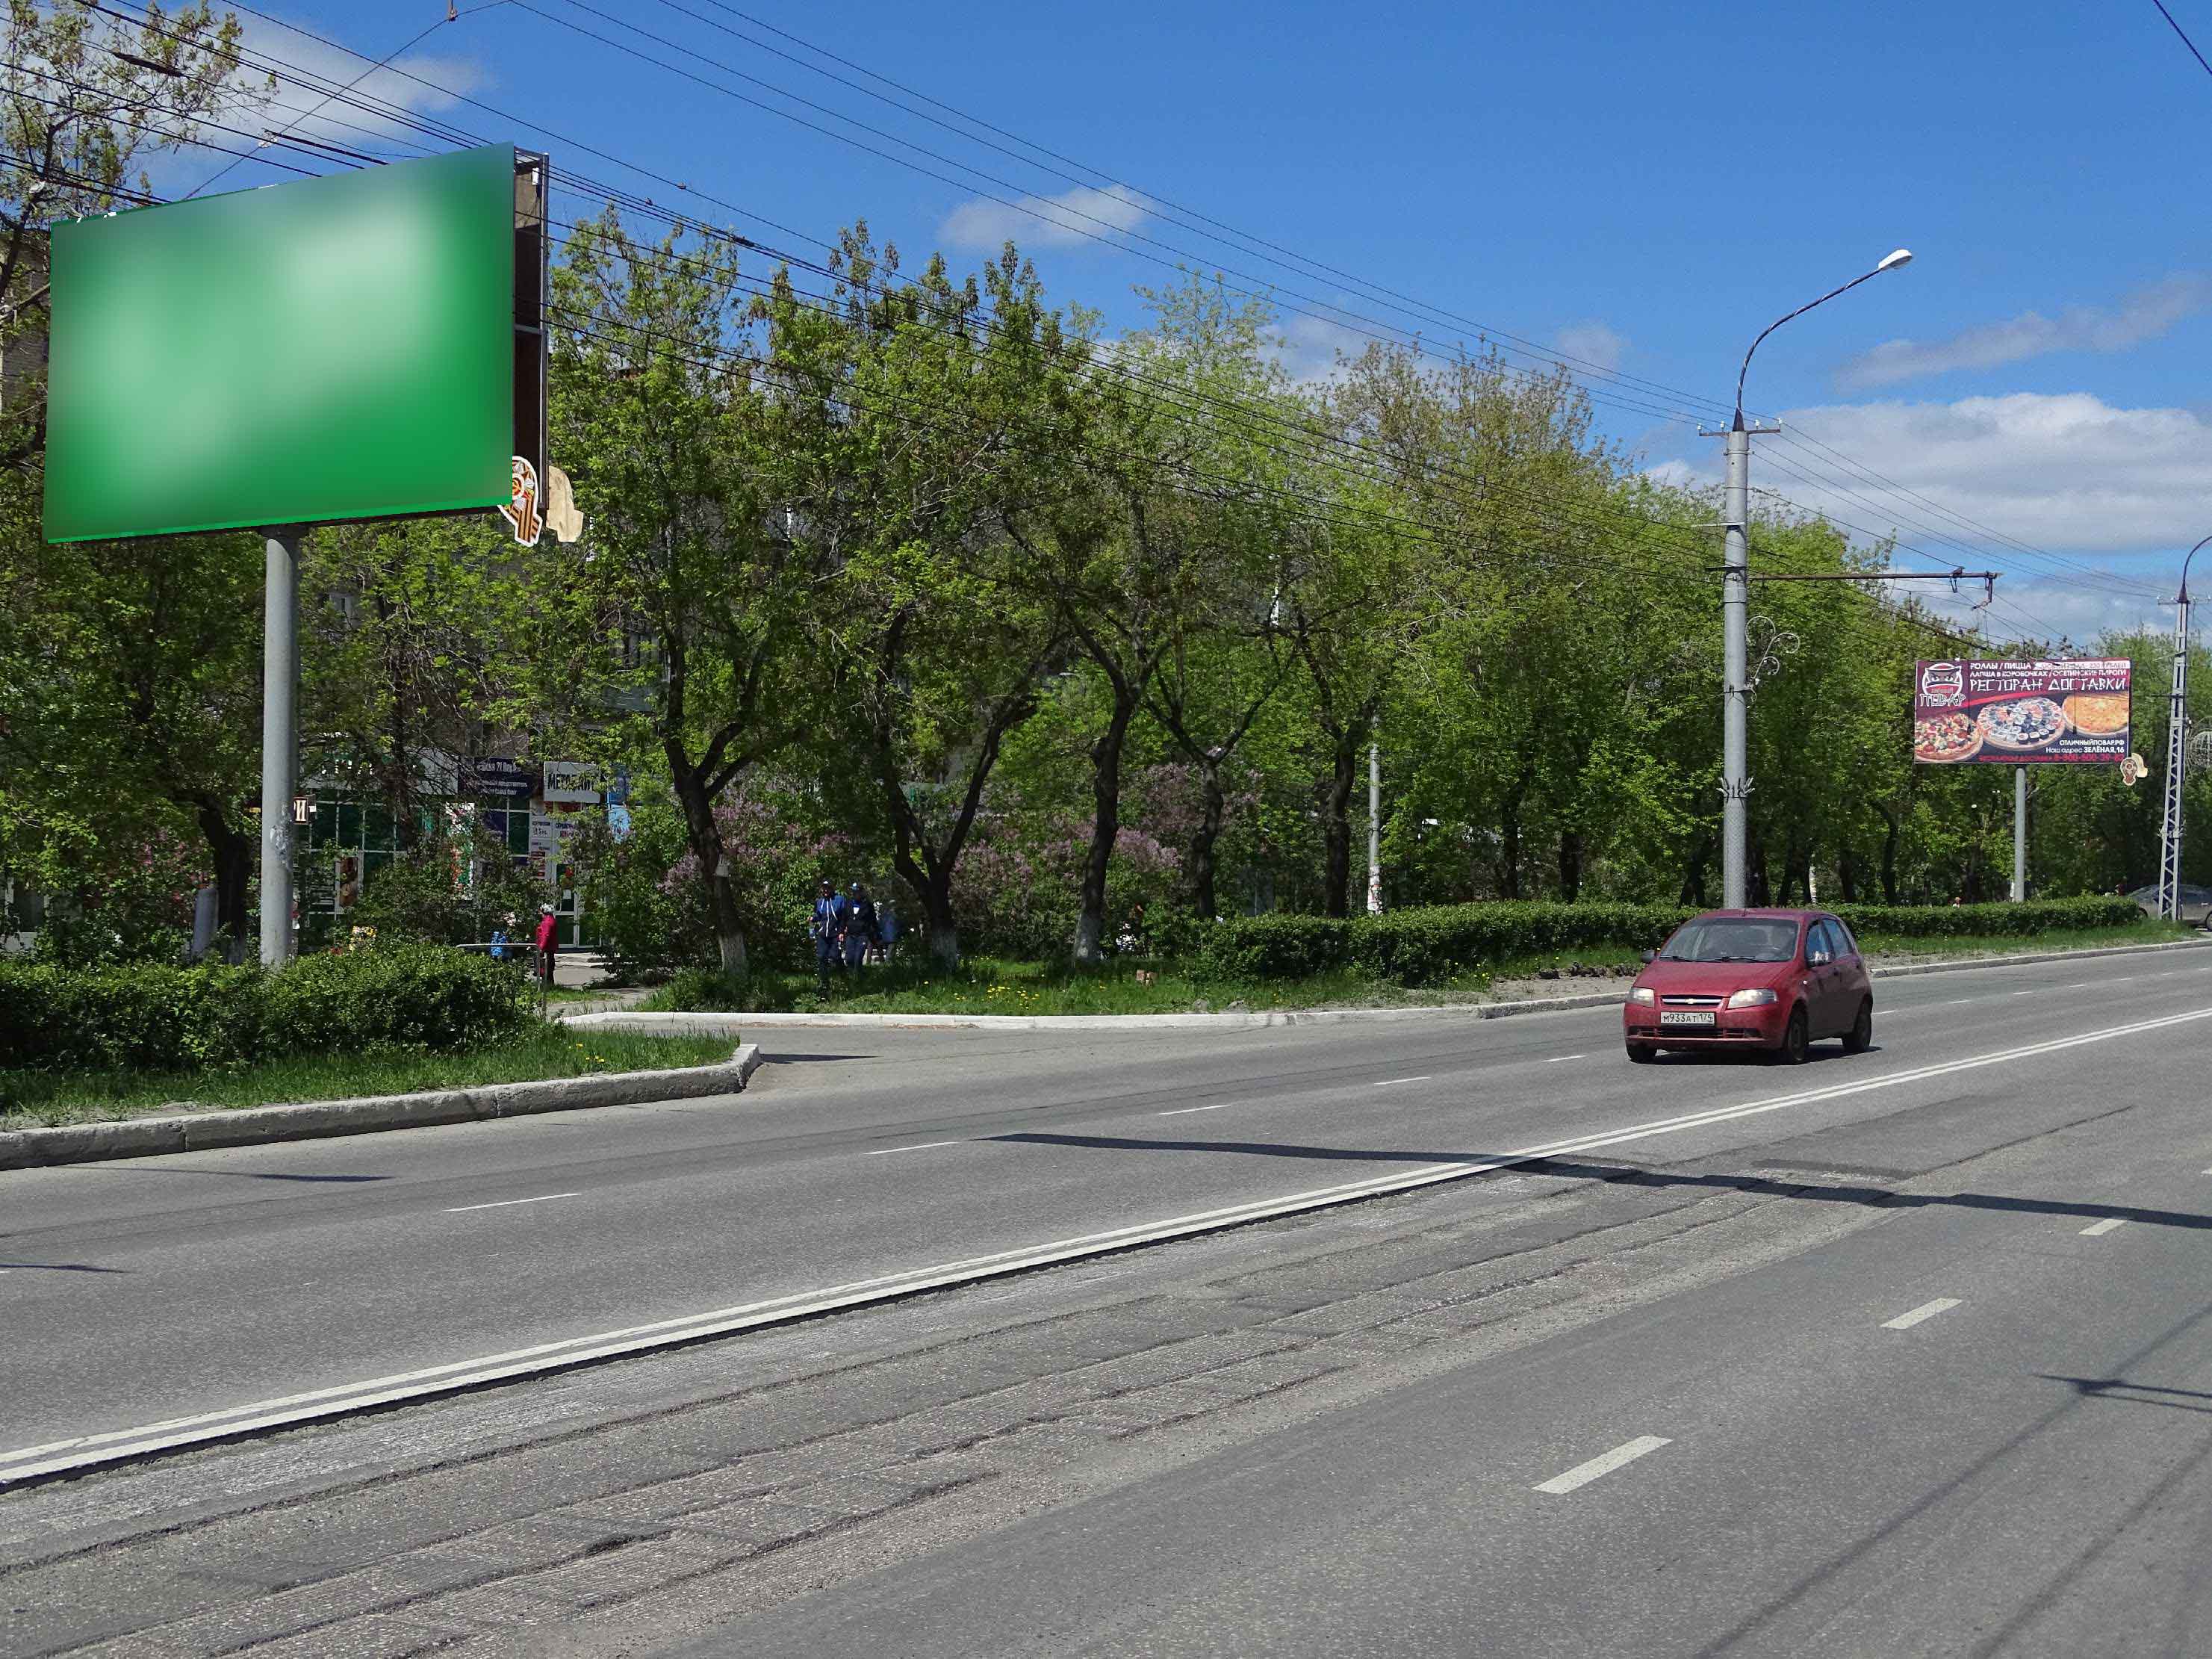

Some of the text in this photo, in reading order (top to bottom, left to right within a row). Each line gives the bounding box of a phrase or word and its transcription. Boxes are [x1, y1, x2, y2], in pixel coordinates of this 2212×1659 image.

[2004, 662, 2032, 670] ПИЦЦА
[1969, 677, 2125, 692] РЕСТОРАН ДОСТАВКИ
